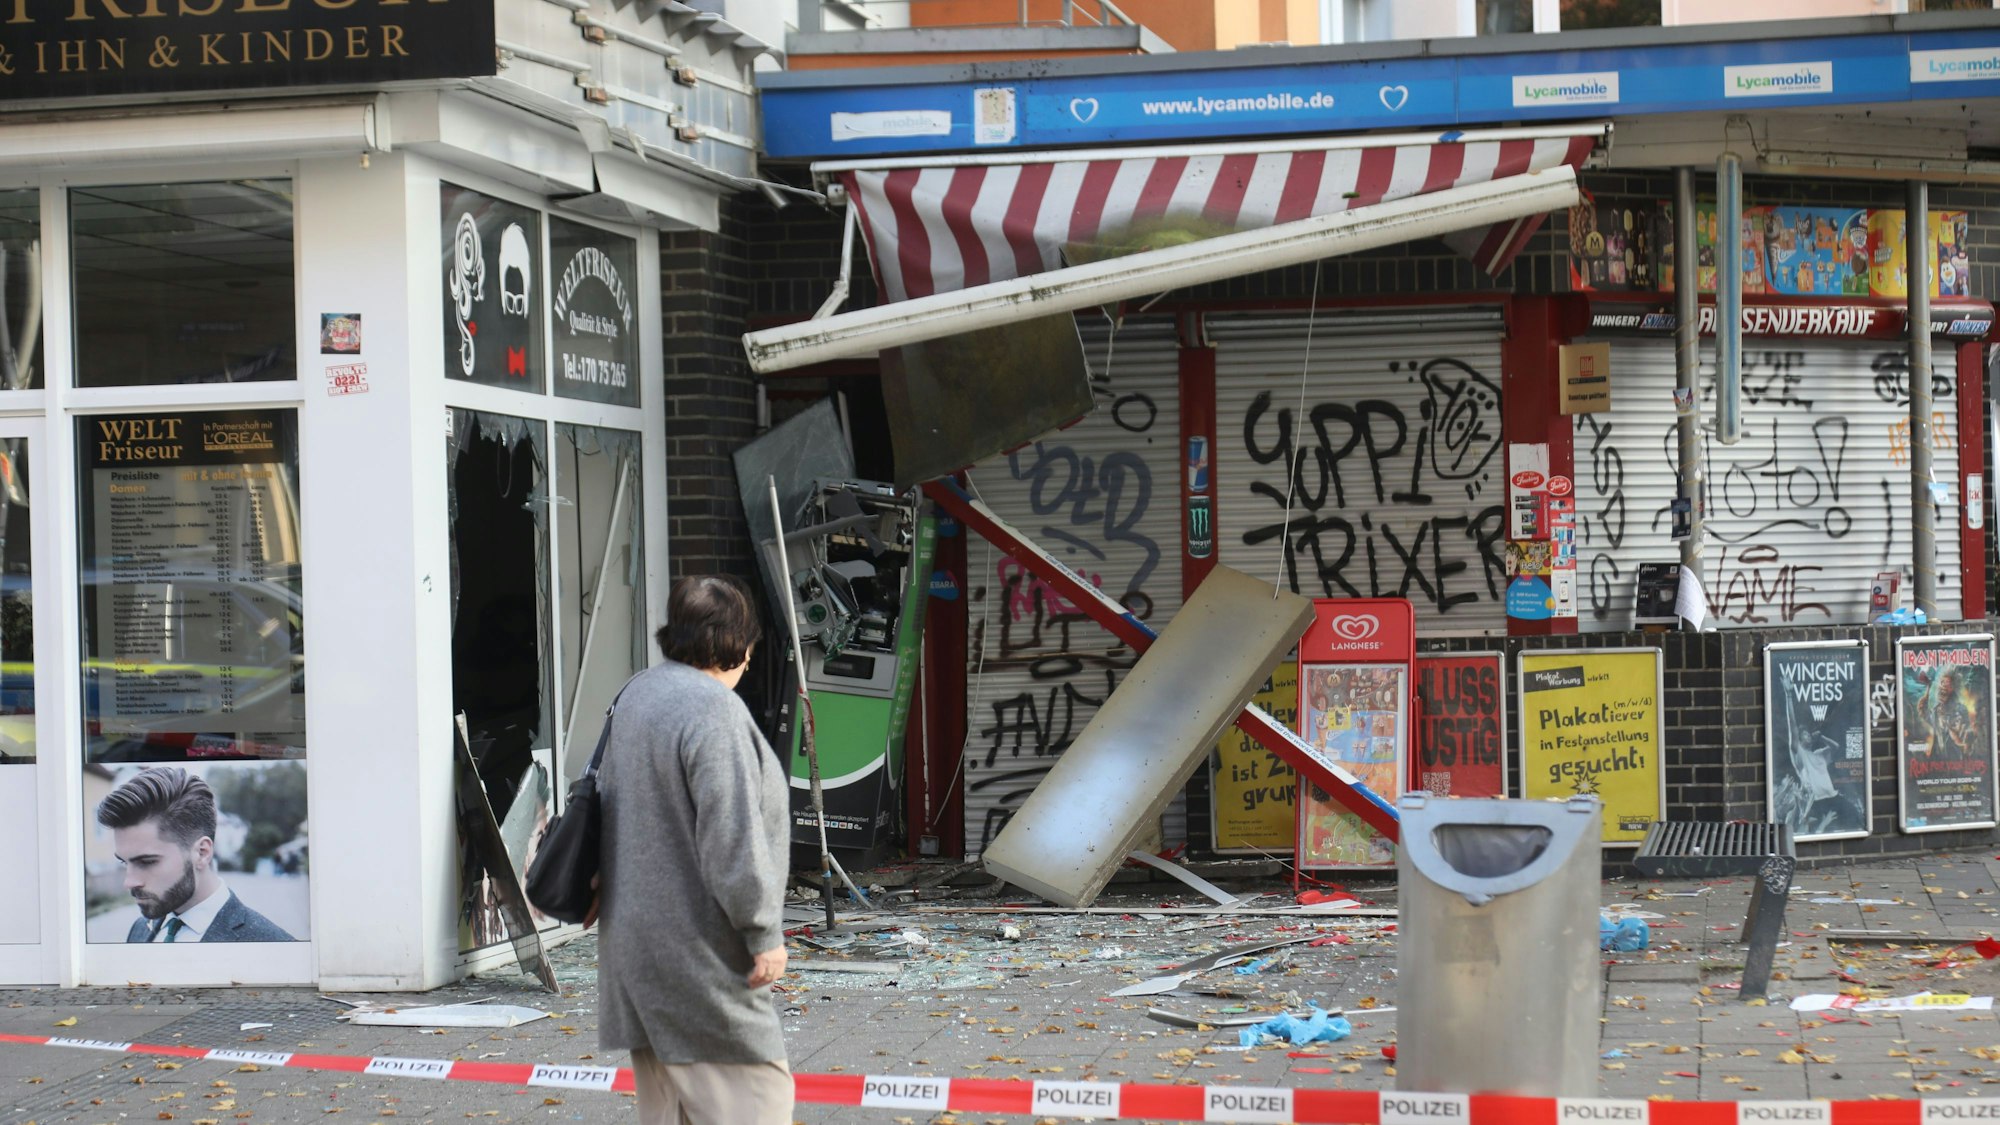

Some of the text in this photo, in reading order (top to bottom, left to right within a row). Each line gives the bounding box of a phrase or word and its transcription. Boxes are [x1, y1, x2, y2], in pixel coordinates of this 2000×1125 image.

[34, 38, 127, 73] IHN
[149, 35, 180, 68] &
[200, 25, 410, 65] KINDER
[1737, 73, 1821, 89] Lycamobile
[1524, 83, 1607, 99] Lycamobile
[1142, 92, 1334, 116] www.lycamobile.de
[554, 247, 631, 334] WELTFRISEUR
[569, 310, 595, 335] Qualität
[1592, 314, 1640, 327] HUNGER?
[1698, 307, 1876, 336] ASENVERKAUF
[598, 359, 609, 385] 75
[611, 362, 626, 388] 265
[98, 418, 182, 440] WELT
[212, 421, 259, 431] Partnerschaft
[99, 441, 183, 461] Friseur
[111, 471, 160, 481] Preisliste
[930, 580, 955, 589] EBARA
[1331, 642, 1380, 650] LANGNESE
[1903, 648, 1990, 670] IRON MAIDEN
[1535, 672, 1560, 682] Plakat
[1779, 662, 1856, 681] WINCENT
[1548, 677, 1581, 687] Werbung
[1793, 683, 1843, 702] WEISS
[1539, 703, 1645, 730] Plakatierer
[1540, 730, 1649, 750] in Festanstellung
[1232, 759, 1259, 782] ist
[1549, 746, 1645, 783] gesucht!
[372, 1060, 444, 1073] POLIZEI
[536, 1068, 609, 1082] POLIZEI
[864, 1082, 939, 1100] POLIZEI
[1037, 1088, 1112, 1107] POLIZEI
[1210, 1094, 1286, 1113] POLIZEI
[1383, 1100, 1461, 1117] POLIZEI
[1563, 1104, 1643, 1121] POLIZEI
[1743, 1106, 1823, 1121] POLIZEI
